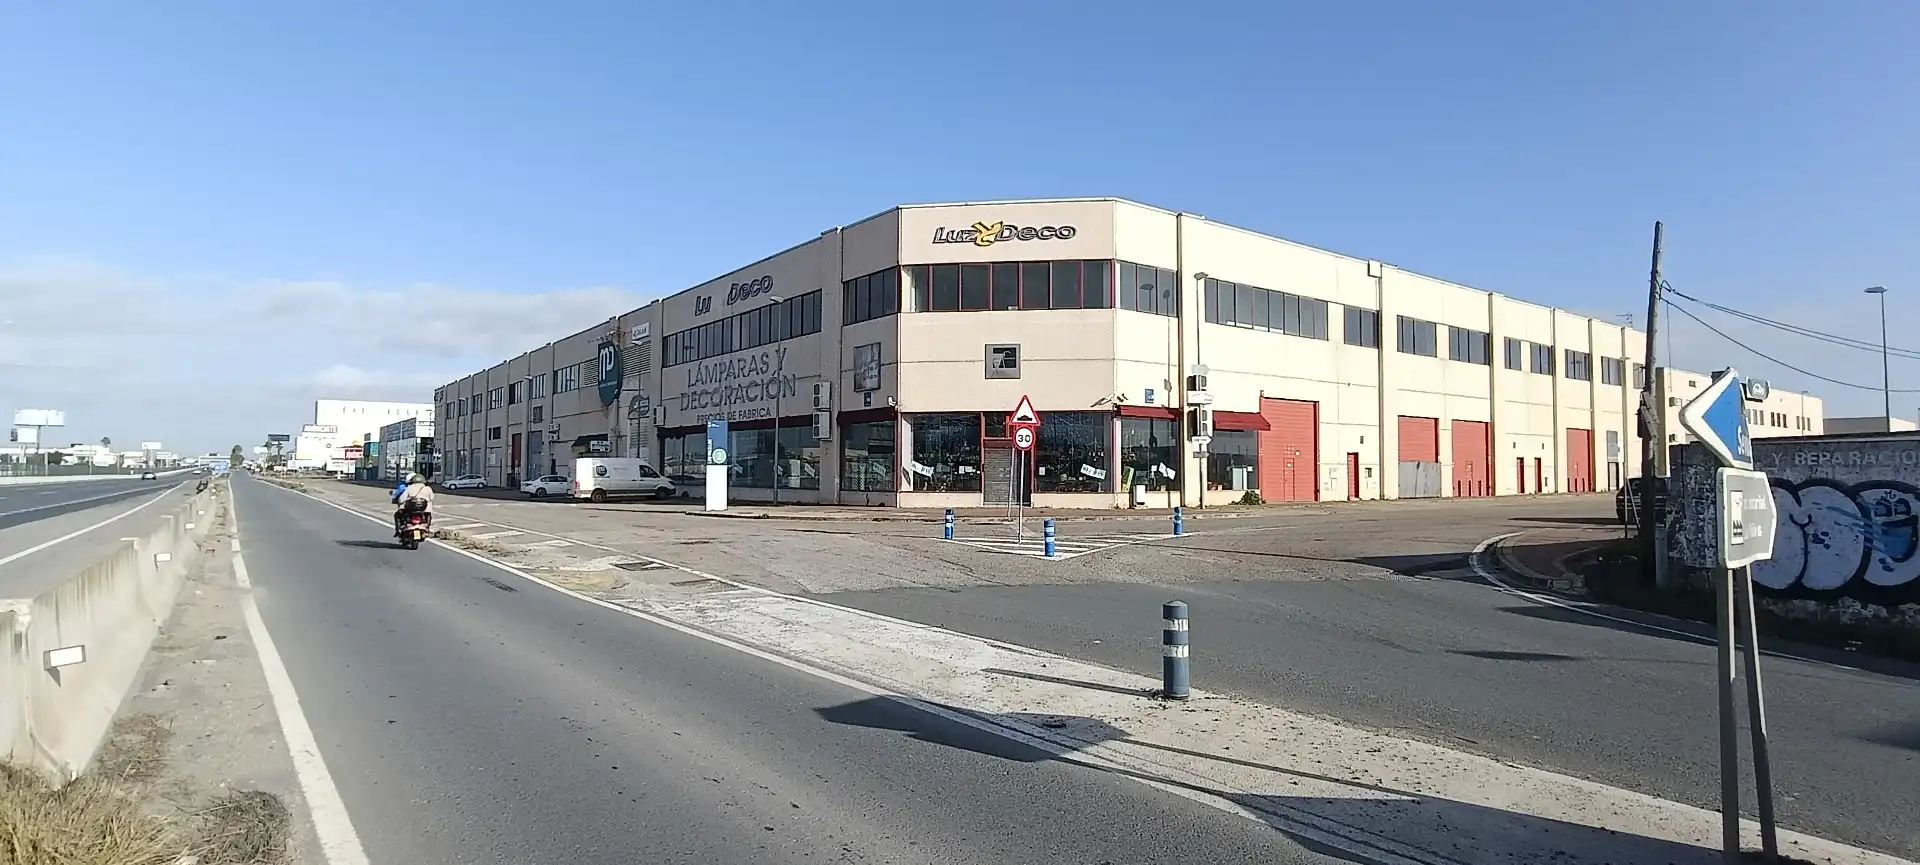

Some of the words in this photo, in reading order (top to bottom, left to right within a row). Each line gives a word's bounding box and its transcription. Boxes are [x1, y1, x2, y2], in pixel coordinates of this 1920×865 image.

[727, 275, 774, 306] Deco
[687, 351, 770, 388] LÁMPARAS
[775, 347, 788, 372] Y
[680, 369, 796, 412] DECORACIÓN
[727, 411, 737, 421] DE
[738, 406, 772, 420] FABRICA
[1017, 434, 1031, 443] 30
